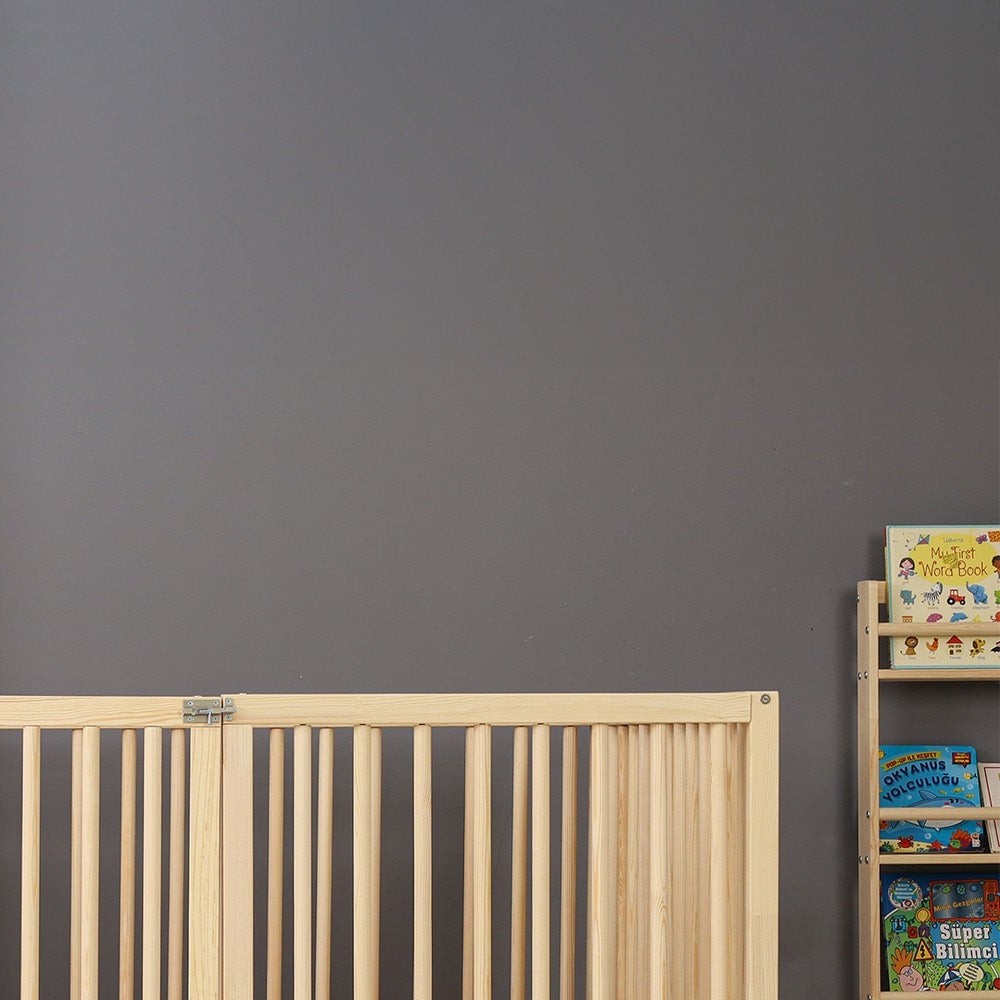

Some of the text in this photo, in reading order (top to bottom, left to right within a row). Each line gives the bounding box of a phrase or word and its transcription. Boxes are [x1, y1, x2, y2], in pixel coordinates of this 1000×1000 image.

[950, 546, 976, 559] First
[957, 559, 988, 577] Book
[883, 760, 947, 786] OKYANUS
[882, 773, 959, 803] YOLCULUĞU
[939, 923, 991, 944] Süper
[935, 943, 999, 960] Bilimci
